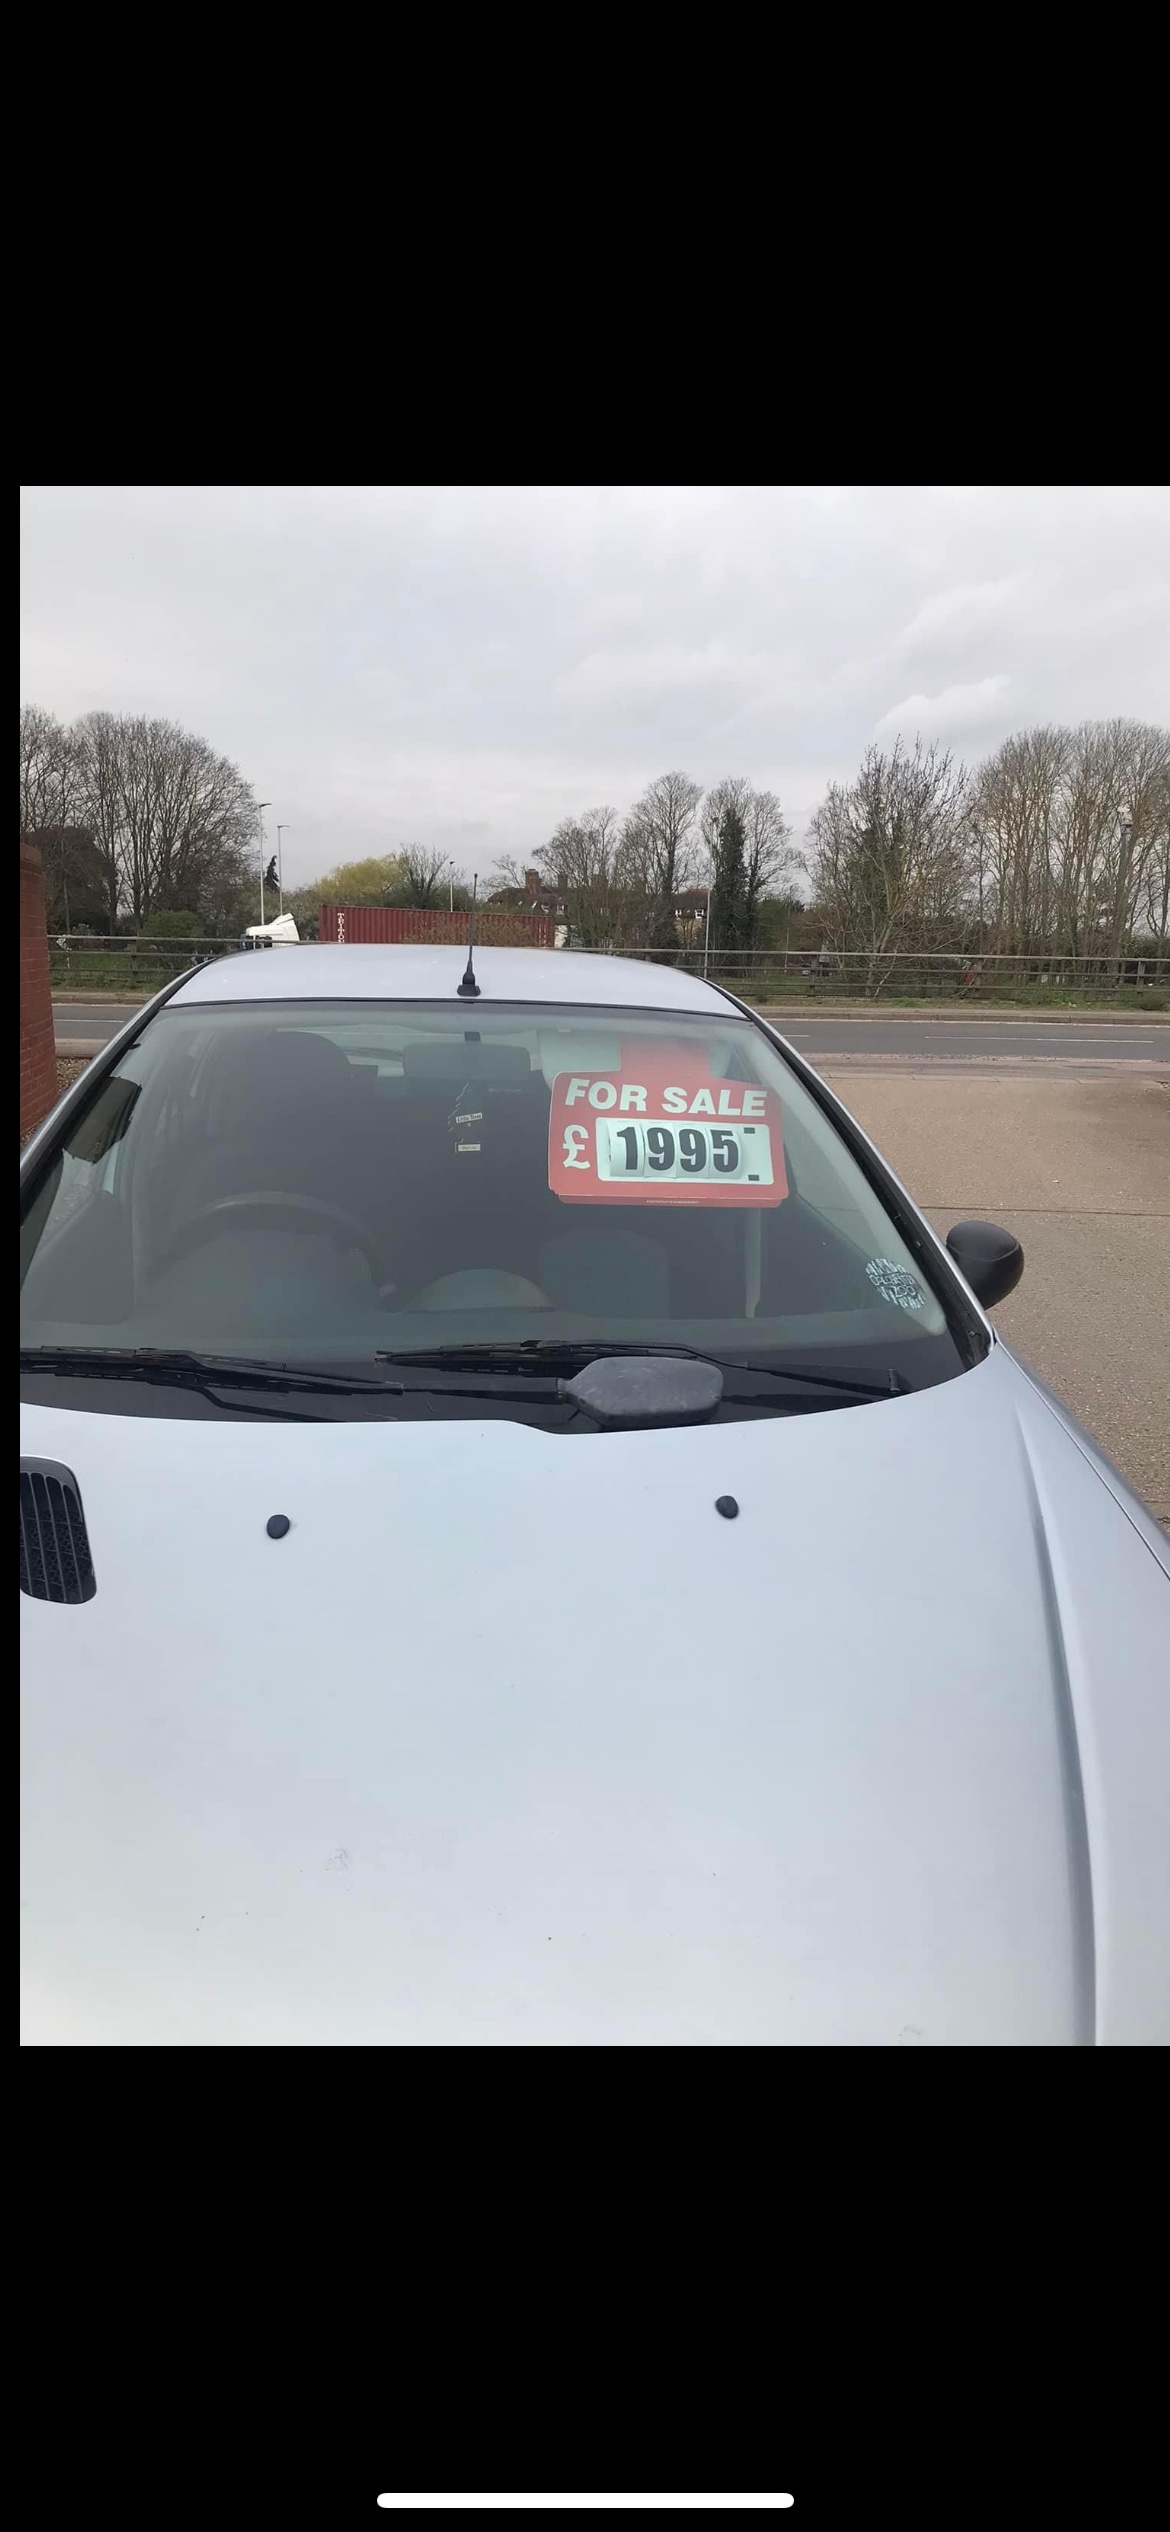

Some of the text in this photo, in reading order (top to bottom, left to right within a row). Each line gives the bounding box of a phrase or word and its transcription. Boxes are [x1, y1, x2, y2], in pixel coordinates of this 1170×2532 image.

[565, 1078, 768, 1117] FOR SALE
[562, 1124, 739, 1173] £ 1995
[889, 1285, 916, 1297] ZOO
